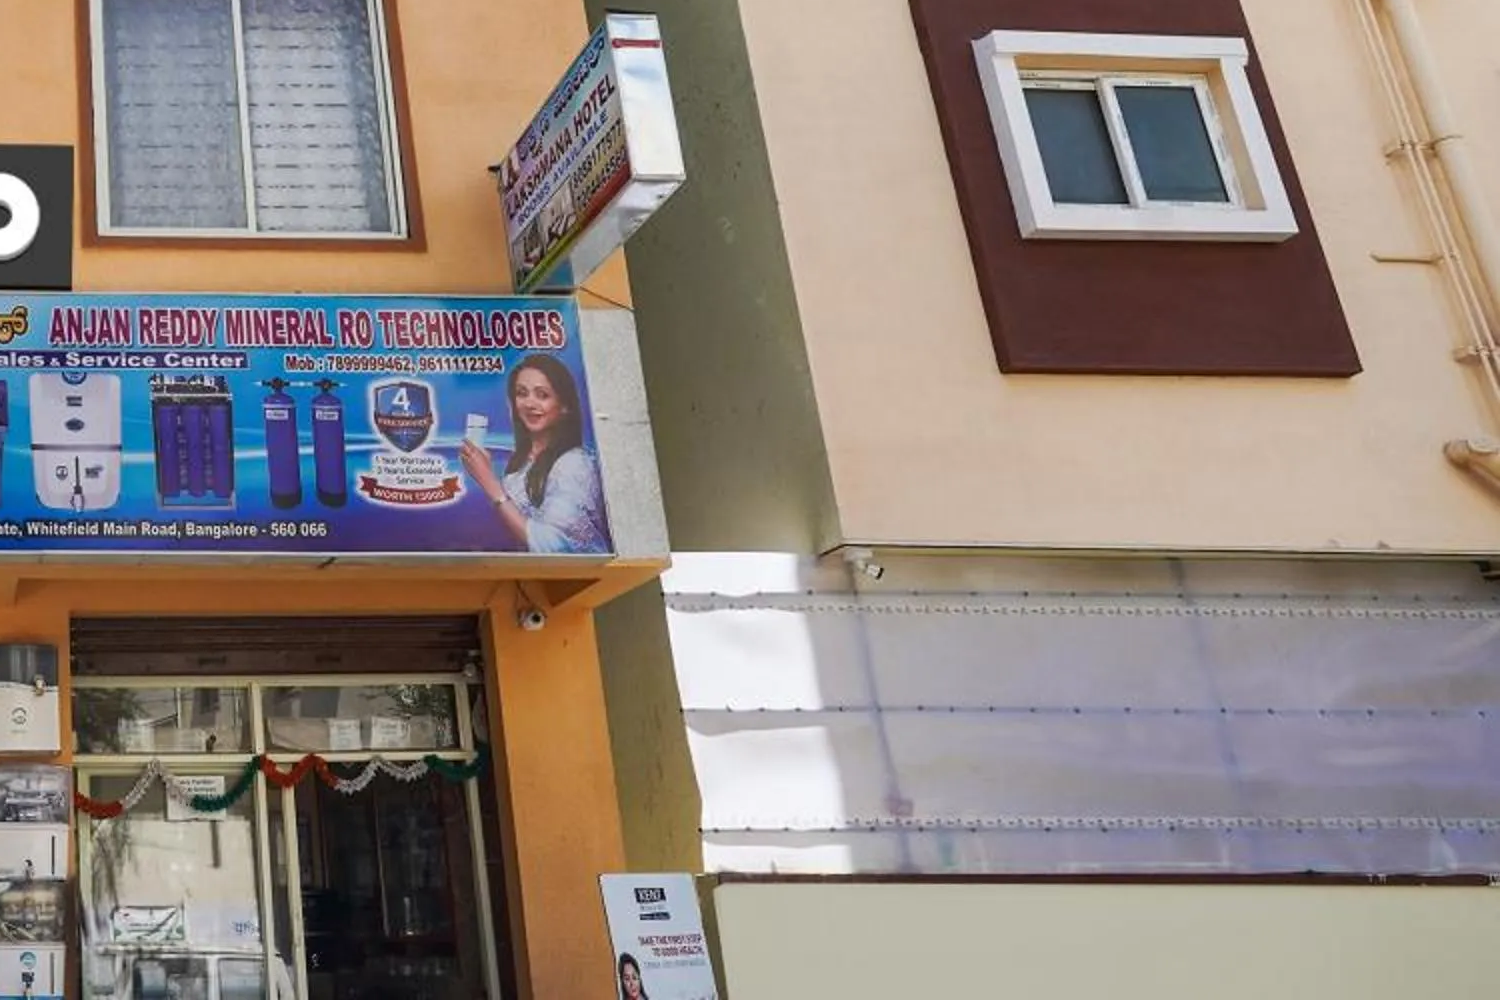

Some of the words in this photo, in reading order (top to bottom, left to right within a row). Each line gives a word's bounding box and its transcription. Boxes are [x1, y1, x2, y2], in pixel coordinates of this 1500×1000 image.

[506, 127, 573, 220] LAKSHMANA
[573, 73, 615, 137] HOTEL
[50, 308, 129, 345] ANJAN
[140, 309, 218, 345] REDDY
[226, 309, 332, 346] MINERAL
[340, 310, 370, 346] RO
[379, 310, 564, 348] TECHNOLOGIES
[50, 357, 60, 366] &
[66, 352, 155, 367] Service
[164, 353, 244, 367] Center
[286, 355, 315, 370] Mob
[392, 387, 410, 411] 4
[373, 487, 412, 501] WORTH
[27, 522, 98, 536] Whitefield
[103, 522, 137, 536] Main
[142, 522, 181, 539] Road,
[186, 522, 257, 539] Bangalore
[271, 522, 295, 537] 560
[301, 523, 327, 537] 066
